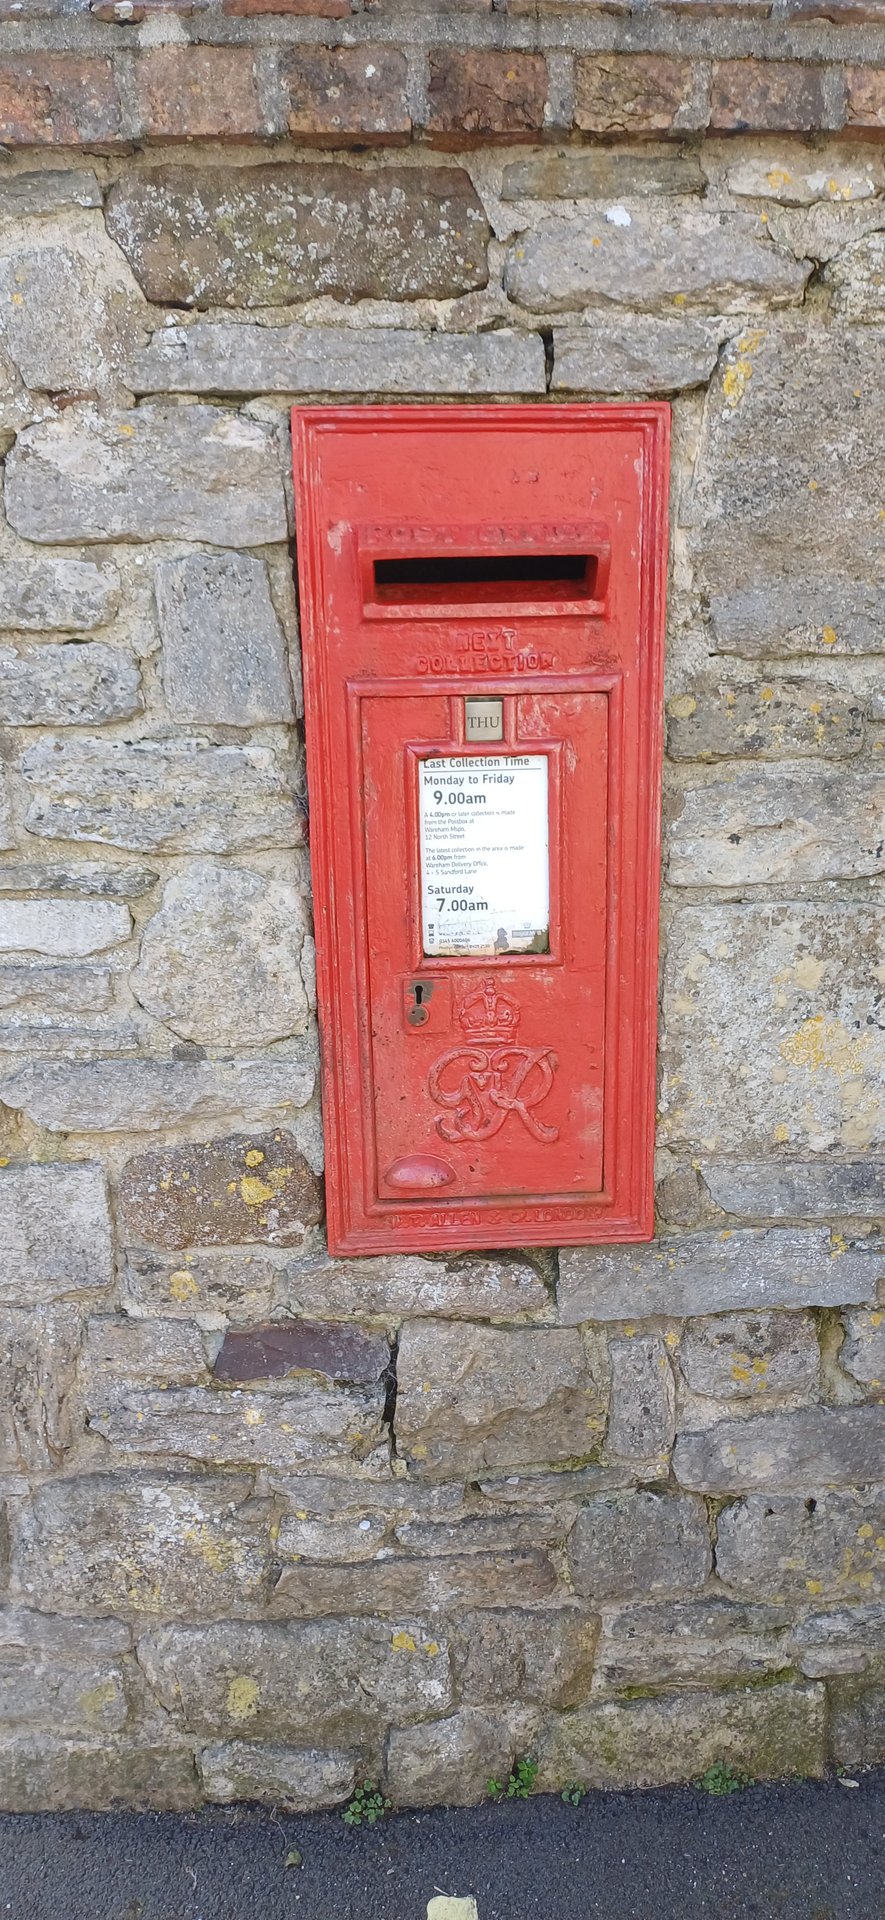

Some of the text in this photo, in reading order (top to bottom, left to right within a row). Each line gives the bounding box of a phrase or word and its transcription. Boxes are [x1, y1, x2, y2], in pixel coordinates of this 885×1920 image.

[456, 630, 516, 652] NEXT
[416, 652, 555, 674] COLLECTION
[467, 716, 500, 728] THU
[423, 756, 530, 769] Last Collection Time
[424, 773, 515, 786] Monday to Friday
[433, 790, 487, 805] 9.00am
[427, 884, 474, 895] Saturday
[436, 898, 488, 912] 7.00am
